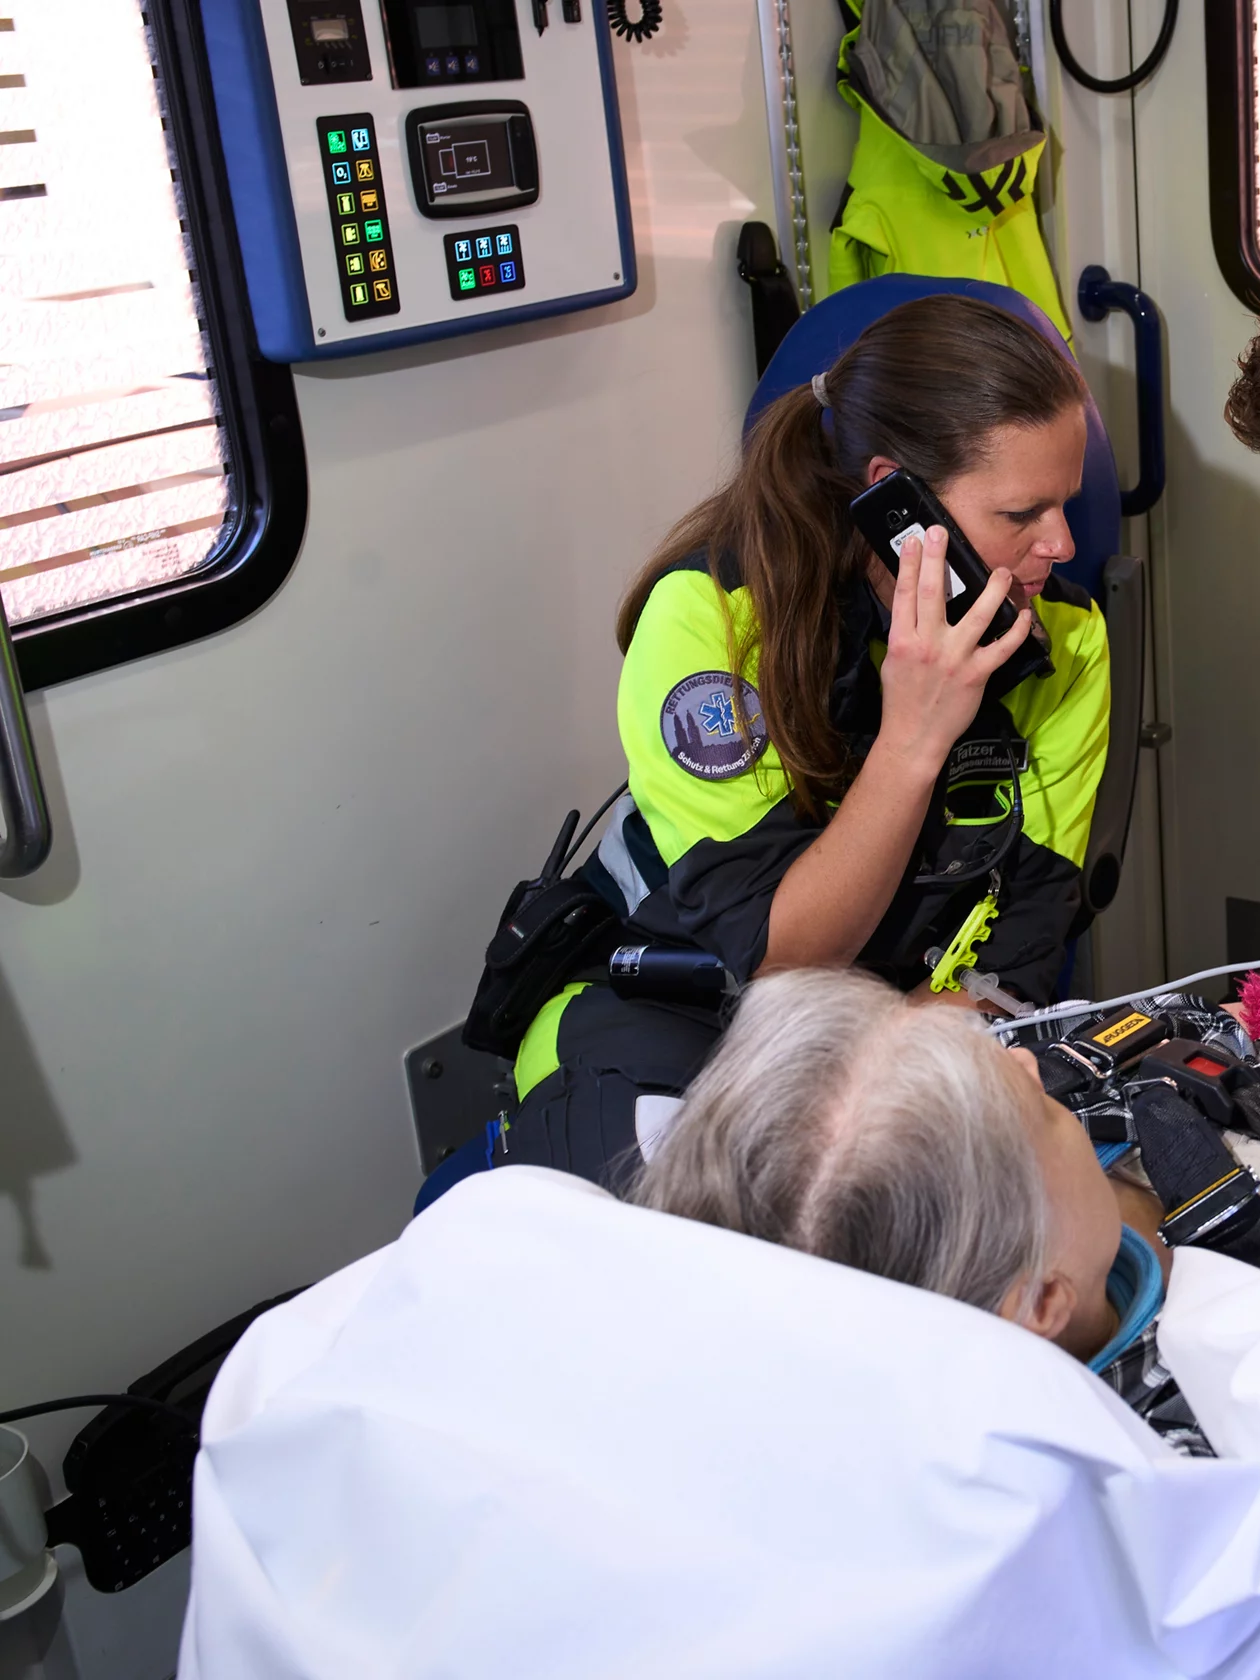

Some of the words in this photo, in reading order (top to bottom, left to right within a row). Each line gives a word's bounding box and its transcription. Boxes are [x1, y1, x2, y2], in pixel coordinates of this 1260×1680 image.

[666, 675, 752, 715] RETTUNGSDIET
[677, 751, 703, 773] Schutz
[704, 766, 711, 774] &
[711, 759, 746, 775] Rettung
[957, 744, 995, 762] Fatzer
